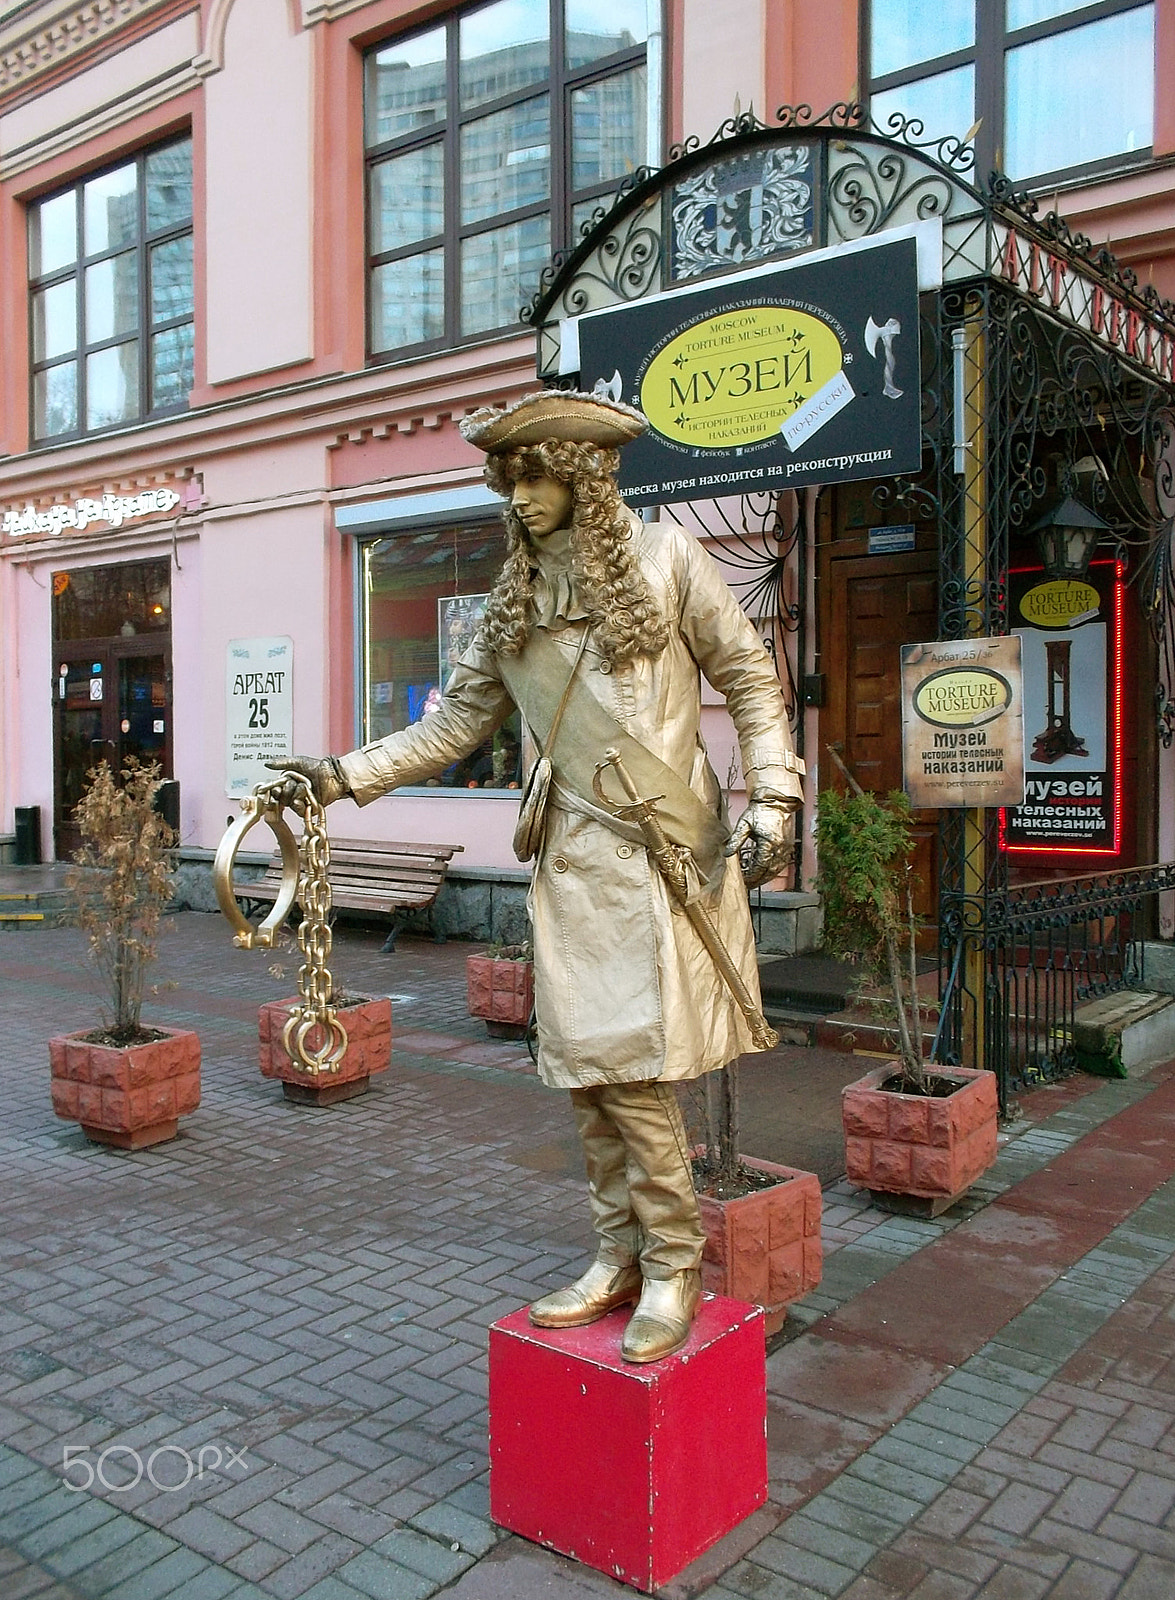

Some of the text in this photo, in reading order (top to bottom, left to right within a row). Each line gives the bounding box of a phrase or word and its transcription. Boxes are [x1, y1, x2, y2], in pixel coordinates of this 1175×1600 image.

[710, 315, 757, 334] MOSCOW
[1091, 284, 1175, 383] BERLI
[685, 324, 786, 353] TORTURE MUSEUM
[669, 346, 813, 408] МУЗЕЙ
[688, 408, 788, 431] ИСТОРИИ ТЕЛЕСНЫХ
[786, 384, 848, 440] по-русски
[708, 423, 767, 440] НАКАЗАНИЙ
[661, 479, 696, 495] музея
[698, 466, 764, 487] находится
[767, 465, 784, 476] на
[785, 448, 892, 478] реконструкции
[1027, 589, 1092, 604] TORTURE
[1029, 601, 1090, 616] MUSEUM
[931, 651, 959, 664] Арбат
[232, 671, 285, 695] АРБАТ
[926, 683, 998, 700] TORTURE
[248, 698, 269, 728] 25
[928, 696, 995, 713] MUSEUM
[934, 729, 987, 749] Музей
[233, 752, 254, 761] Денис
[921, 748, 1004, 760] истории телесных
[923, 757, 1004, 775] наказаний
[1016, 805, 1102, 817] телесных
[1011, 816, 1106, 830] наказаний
